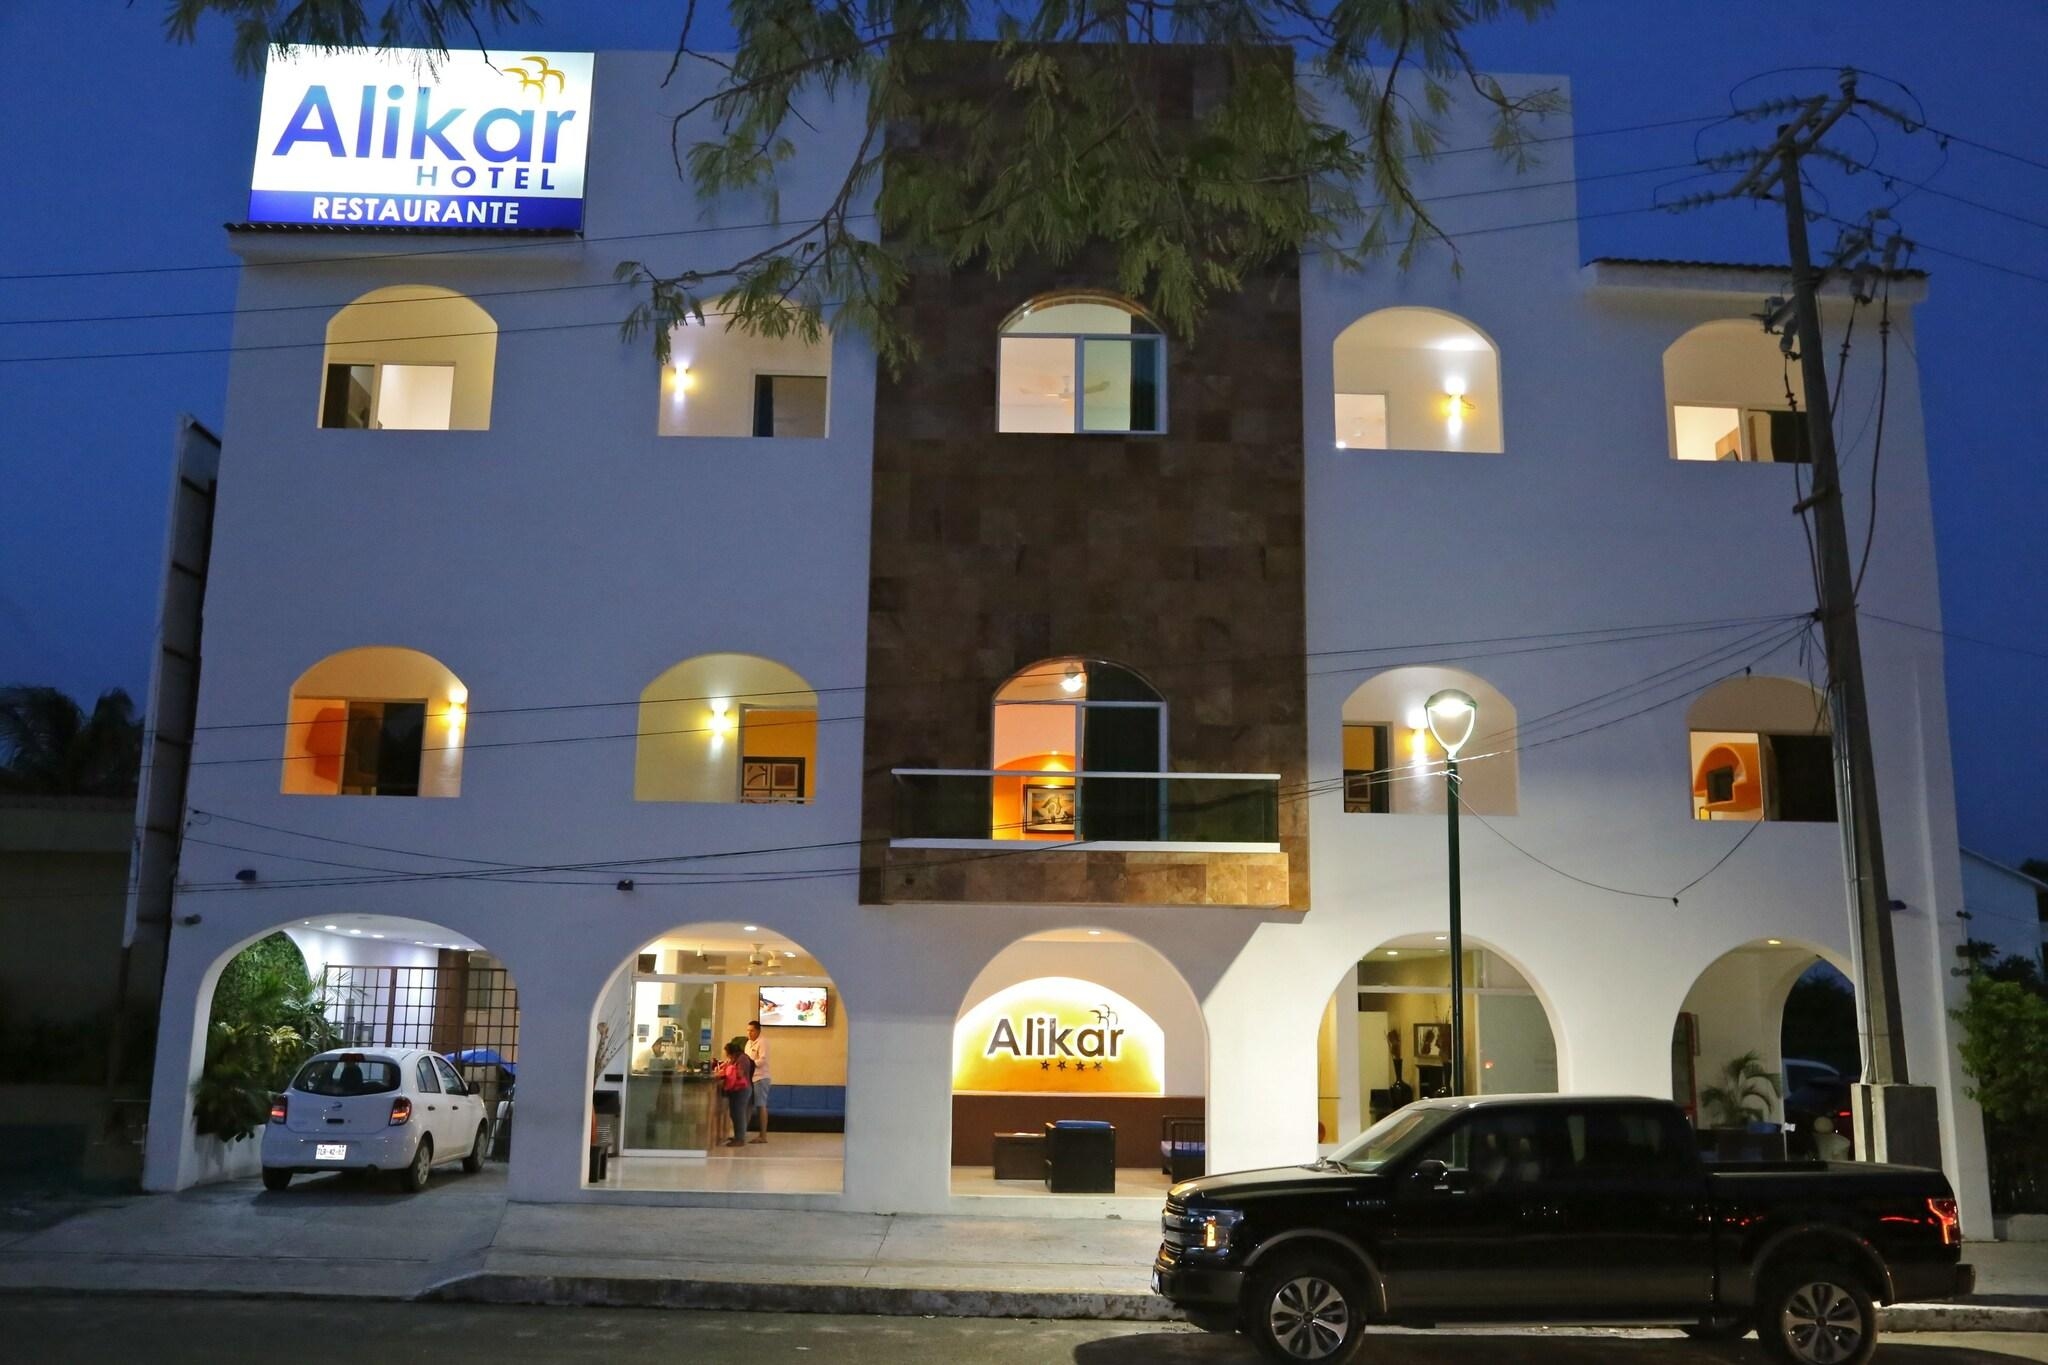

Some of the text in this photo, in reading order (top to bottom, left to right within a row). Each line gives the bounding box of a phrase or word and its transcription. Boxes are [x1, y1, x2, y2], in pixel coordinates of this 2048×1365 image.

[272, 84, 577, 164] Alikar
[416, 165, 555, 190] HOTEL
[312, 196, 520, 225] RESTAURANTE
[987, 1017, 1125, 1057] Alikar
